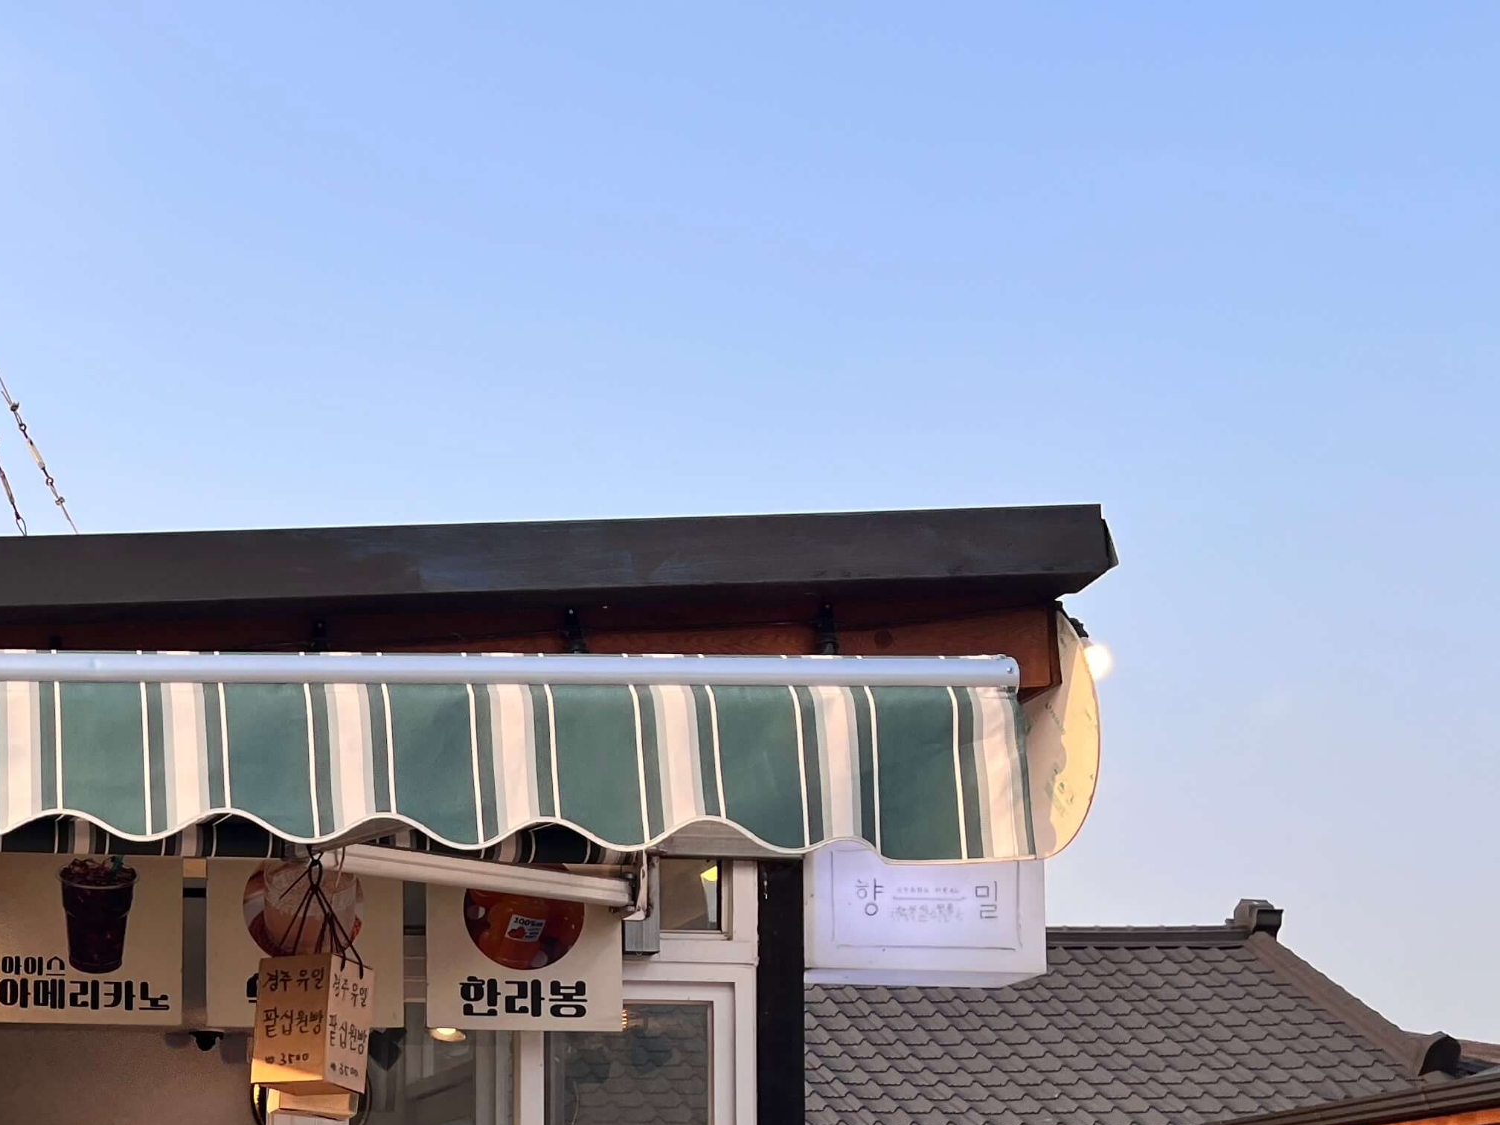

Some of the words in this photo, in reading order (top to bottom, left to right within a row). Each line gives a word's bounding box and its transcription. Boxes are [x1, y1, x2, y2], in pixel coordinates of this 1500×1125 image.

[854, 878, 885, 917] 향
[974, 880, 999, 919] 밀
[1, 955, 66, 976] 아이스
[262, 969, 293, 993] 경주
[296, 966, 325, 992] 유일
[458, 976, 588, 1018] 한라봉
